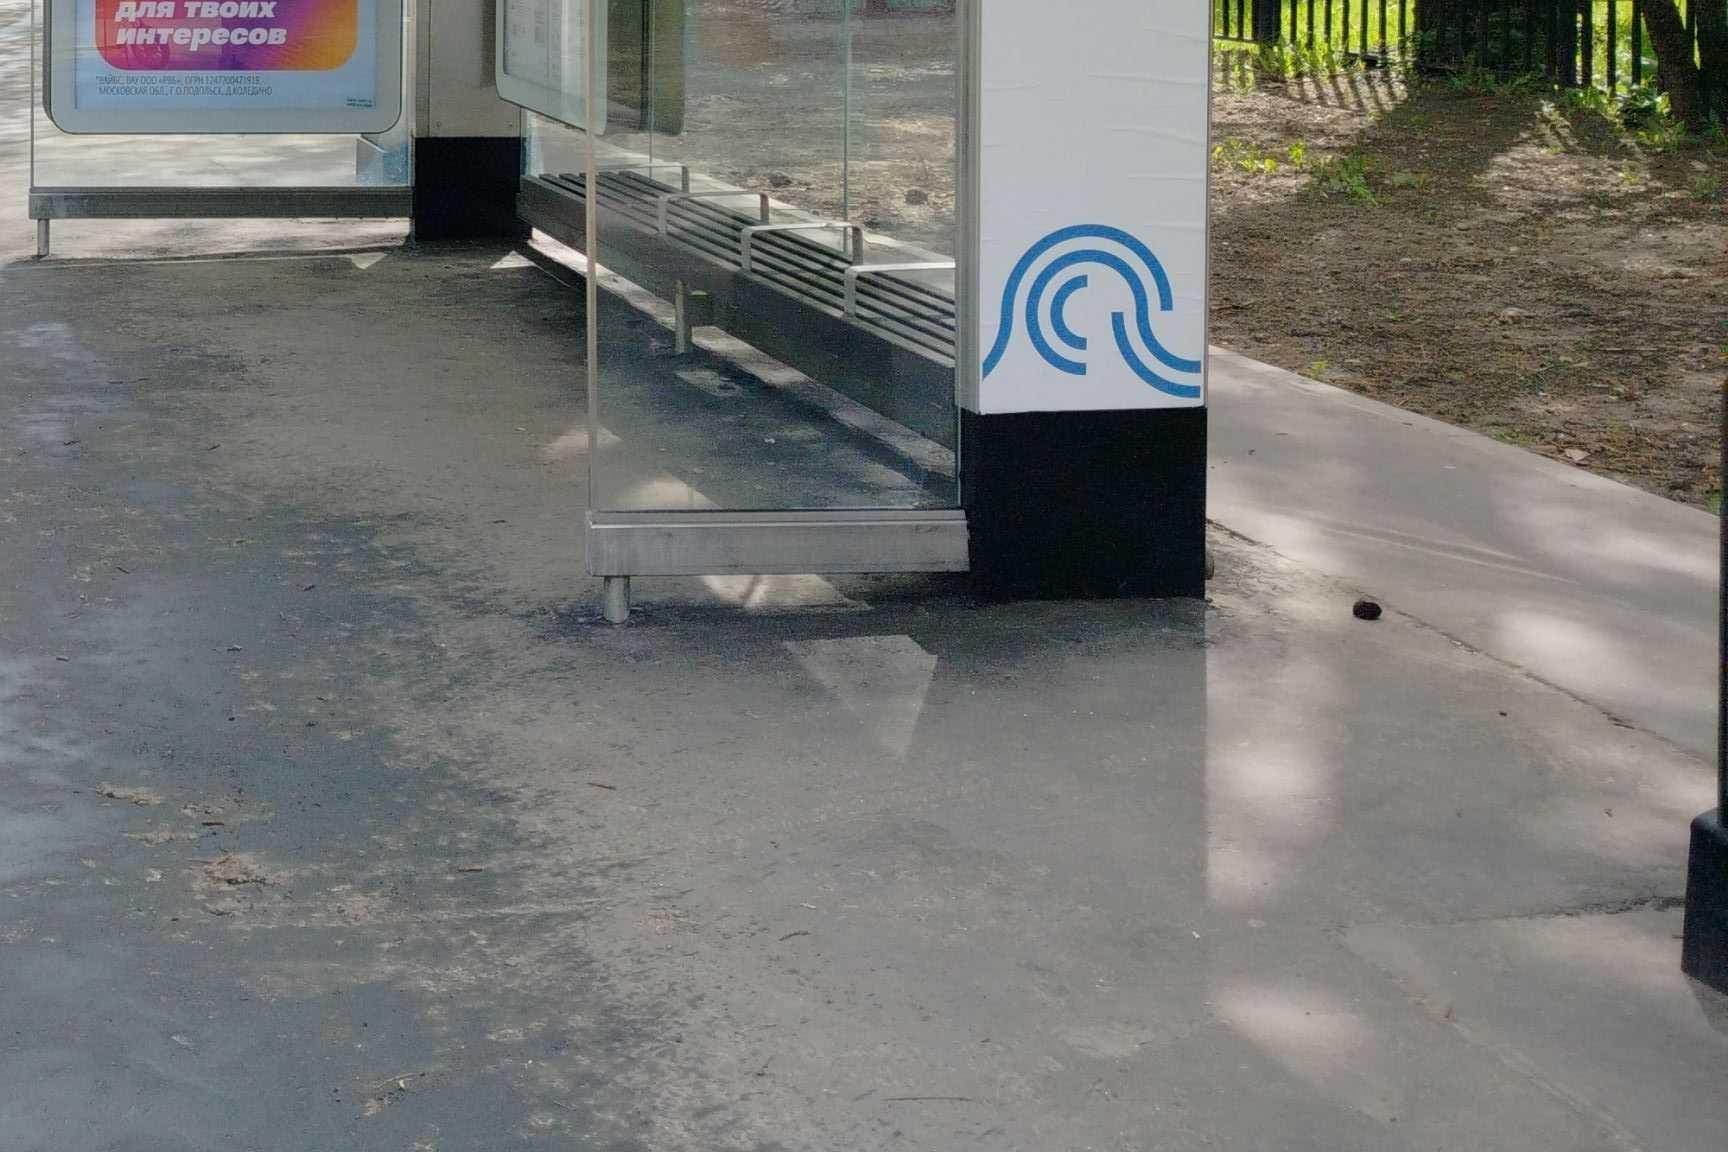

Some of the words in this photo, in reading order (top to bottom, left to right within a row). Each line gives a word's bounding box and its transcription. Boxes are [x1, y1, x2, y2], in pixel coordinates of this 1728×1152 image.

[114, 0, 176, 22] для
[183, 0, 278, 19] твоих
[116, 27, 288, 52] интересов
